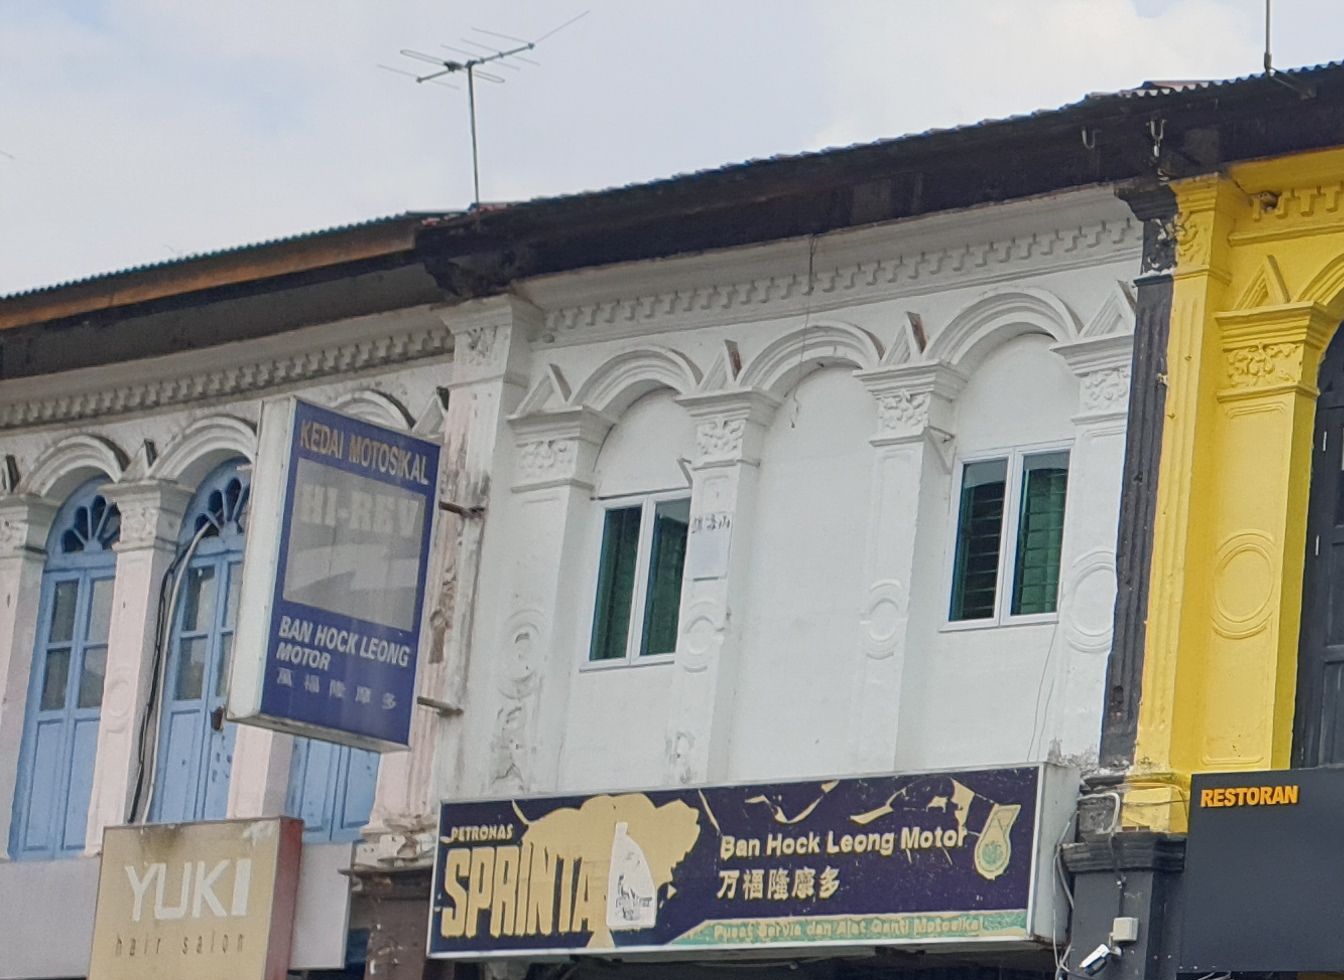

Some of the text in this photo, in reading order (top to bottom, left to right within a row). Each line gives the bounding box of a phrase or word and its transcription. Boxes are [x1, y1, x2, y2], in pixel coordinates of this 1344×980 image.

[300, 419, 344, 460] KEDAI
[276, 642, 332, 671] MOTOR
[278, 615, 411, 667] BAN HOCK LEONG
[1200, 785, 1299, 808] RESTORAN
[451, 823, 514, 842] PETRONAS
[720, 826, 968, 860] Ban Hock Leong Motor
[124, 858, 252, 922] YUKI
[441, 844, 595, 938] SPRINTA
[115, 930, 244, 957] hair salon
